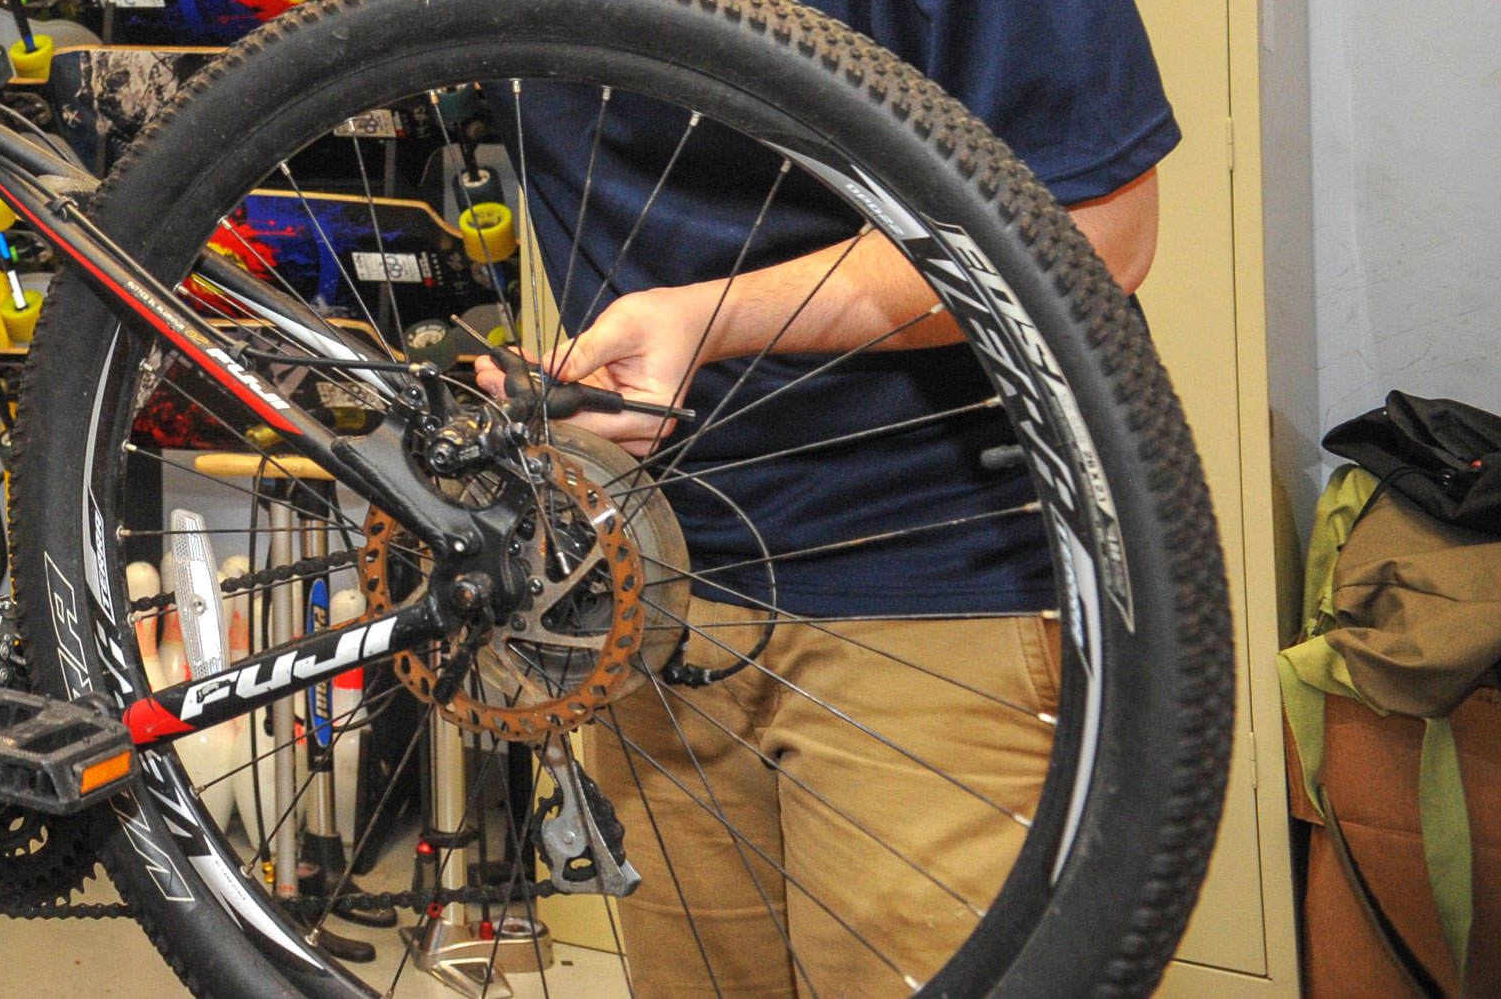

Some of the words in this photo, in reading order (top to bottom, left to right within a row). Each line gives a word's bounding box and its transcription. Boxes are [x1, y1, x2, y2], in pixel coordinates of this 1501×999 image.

[205, 348, 291, 410] FUJI
[94, 509, 112, 611] TERRA
[180, 616, 398, 722] FUJI
